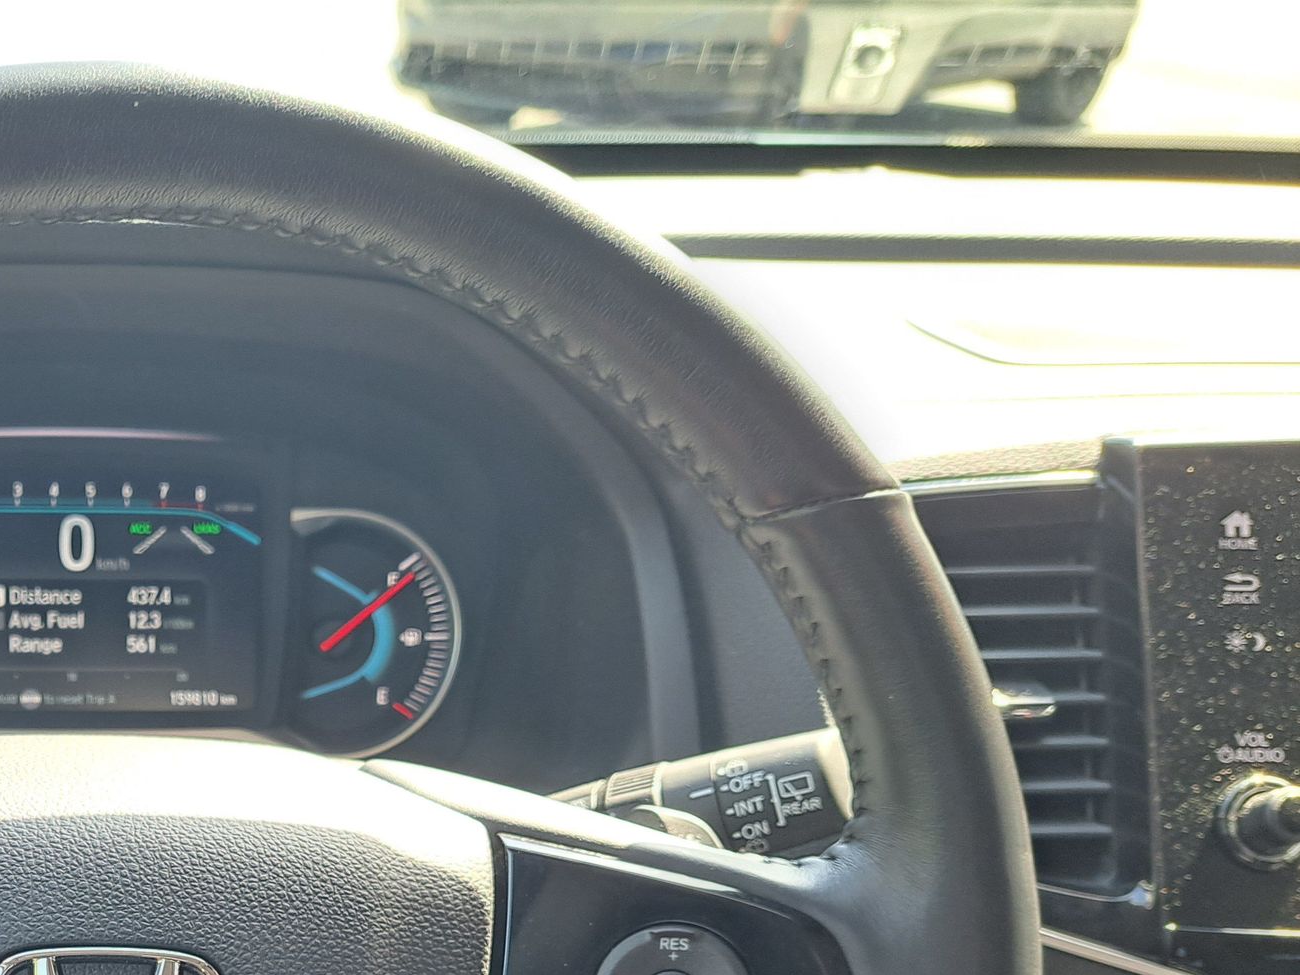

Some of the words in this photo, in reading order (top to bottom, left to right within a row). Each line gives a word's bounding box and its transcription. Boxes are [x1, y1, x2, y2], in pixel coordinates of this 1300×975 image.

[58, 513, 96, 572] 0
[8, 586, 83, 605] Distance
[127, 586, 172, 605] 437.4
[8, 610, 44, 631] Avg.
[47, 610, 85, 629] Fuel
[129, 610, 162, 629] 12.3
[8, 634, 63, 655] Range
[126, 634, 156, 653] 561
[1234, 733, 1269, 748] VOL
[1235, 747, 1286, 764] AUDIO
[729, 770, 766, 793] OFF
[734, 795, 764, 818] INT
[781, 797, 823, 817] REAR
[741, 820, 771, 840] ON
[659, 937, 689, 951] RES
